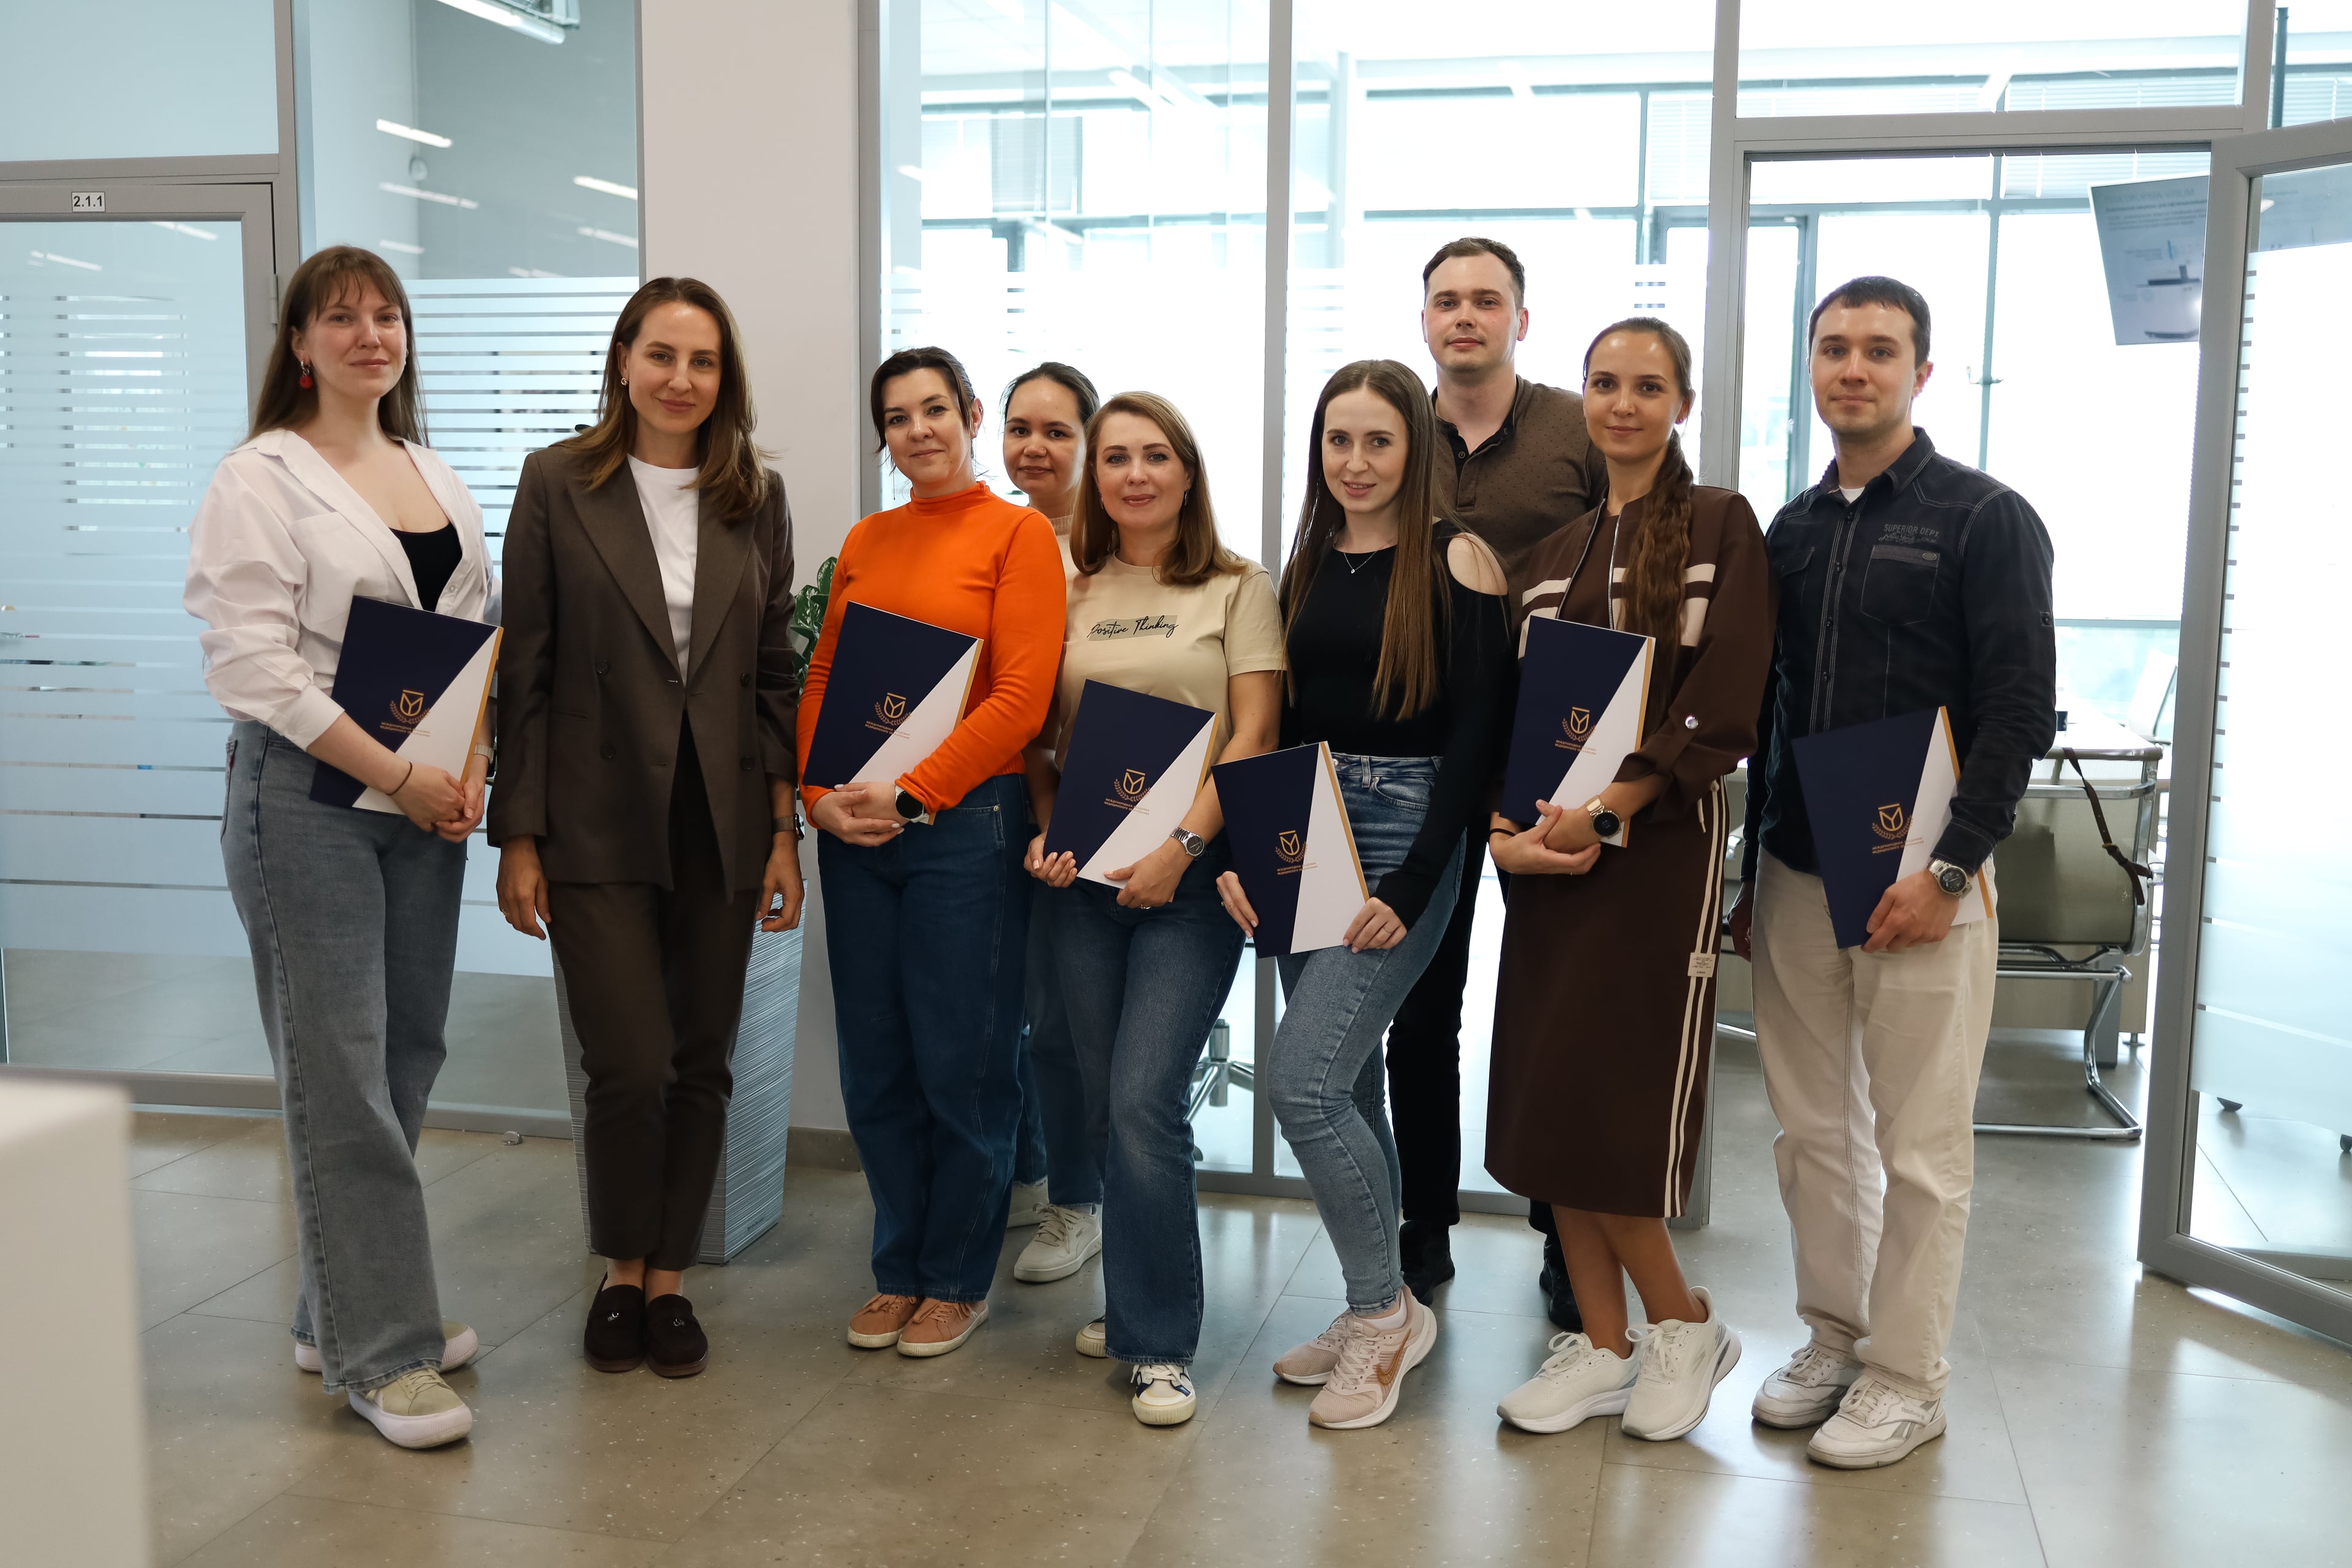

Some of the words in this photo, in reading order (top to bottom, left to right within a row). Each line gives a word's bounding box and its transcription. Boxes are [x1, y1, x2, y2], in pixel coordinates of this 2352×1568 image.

[73, 195, 102, 207] 2.1.1
[1883, 524, 1918, 534] SUPERIOR
[1087, 621, 1128, 638] Positive
[1133, 615, 1179, 638] Thinking
